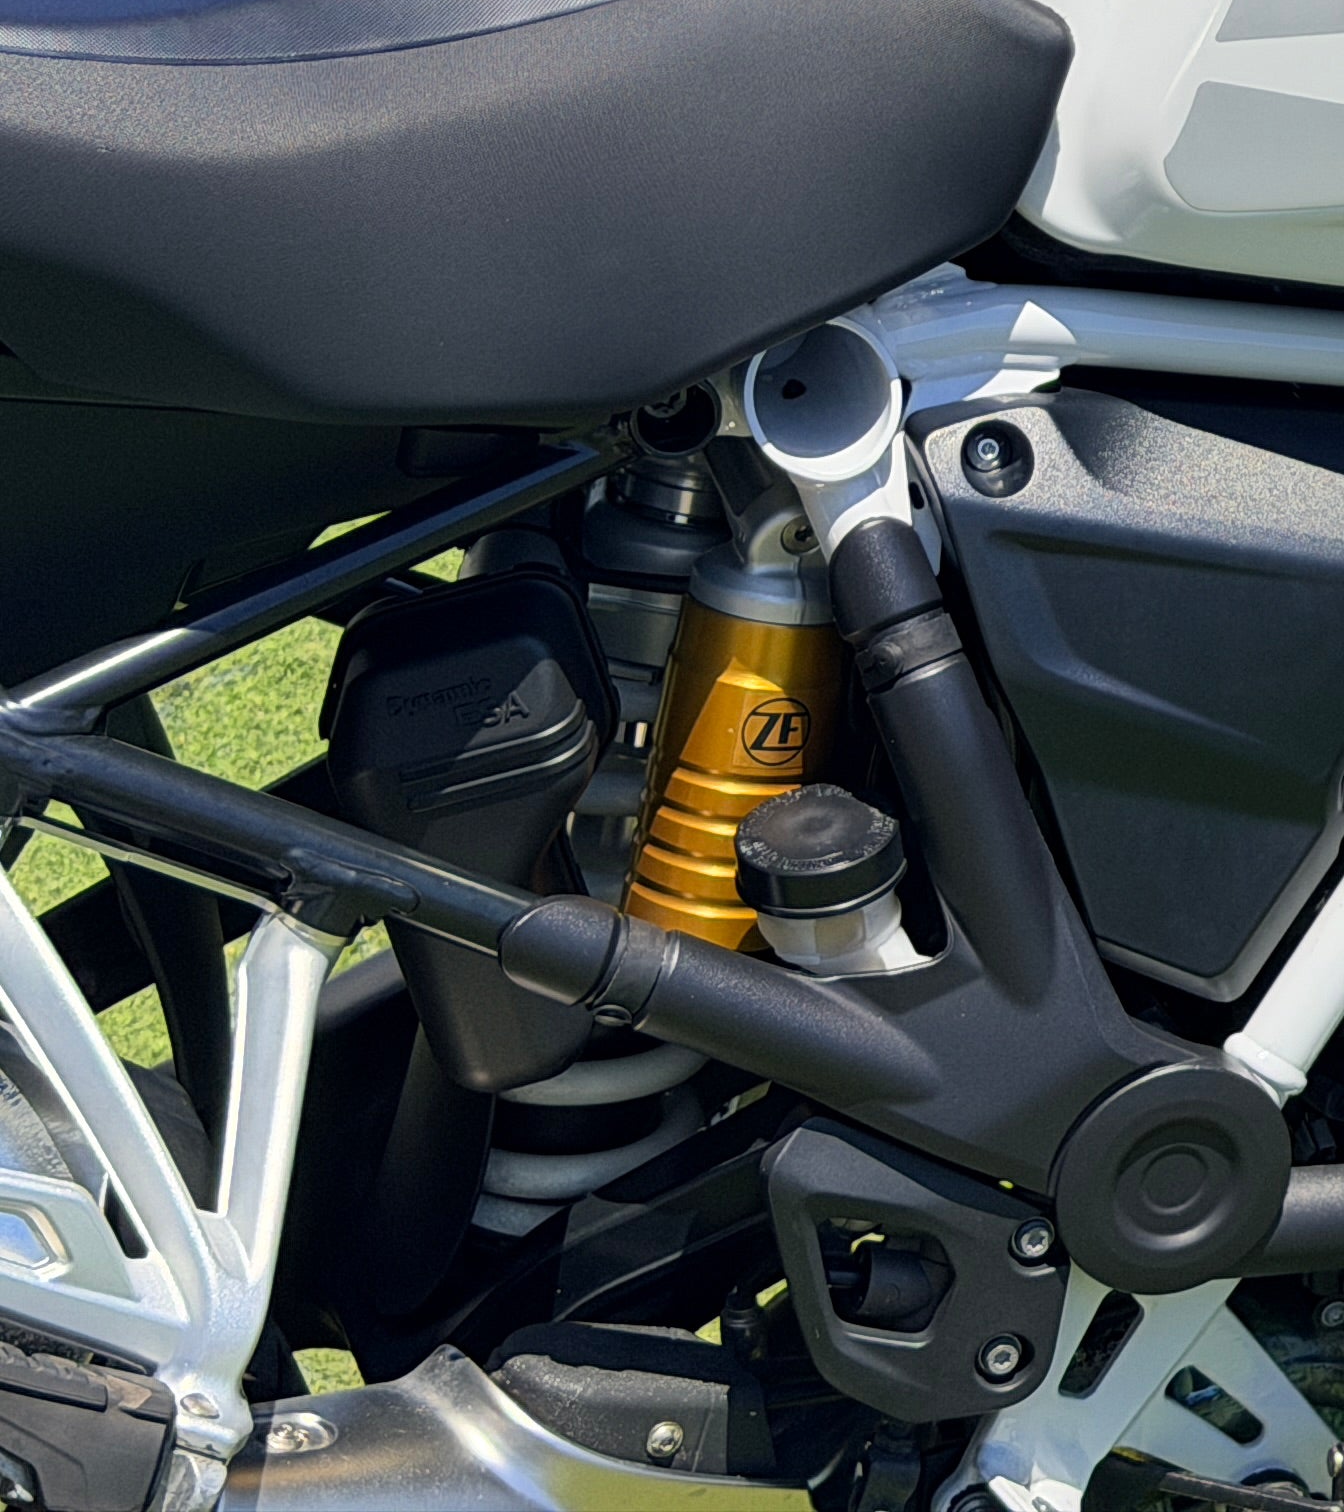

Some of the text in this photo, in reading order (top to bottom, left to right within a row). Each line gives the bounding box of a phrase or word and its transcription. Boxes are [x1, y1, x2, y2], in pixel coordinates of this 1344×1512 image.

[386, 676, 492, 716] Dynamic
[453, 689, 530, 727] ESA
[749, 710, 809, 752] ZF
